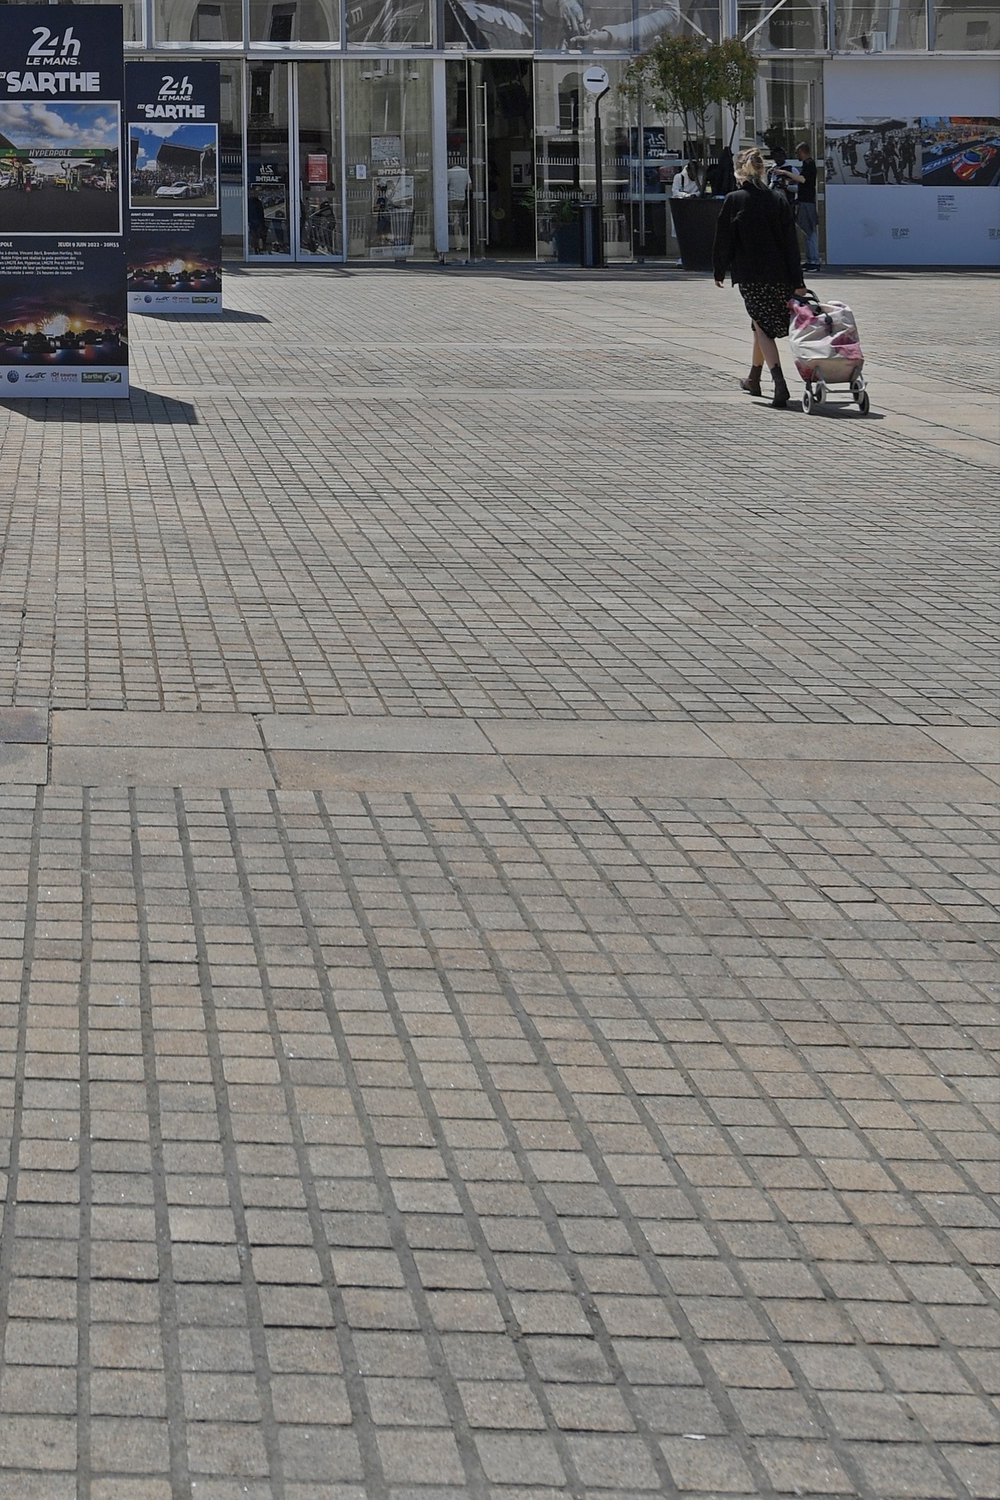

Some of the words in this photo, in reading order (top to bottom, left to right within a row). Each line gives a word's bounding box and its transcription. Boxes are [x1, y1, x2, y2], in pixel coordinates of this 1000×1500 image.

[28, 26, 82, 56] 24h
[26, 57, 41, 66] LE
[6, 72, 100, 95] SARTHE
[158, 76, 194, 95] 24h
[144, 104, 206, 120] SARTHE
[28, 149, 72, 157] HYPERPOLE
